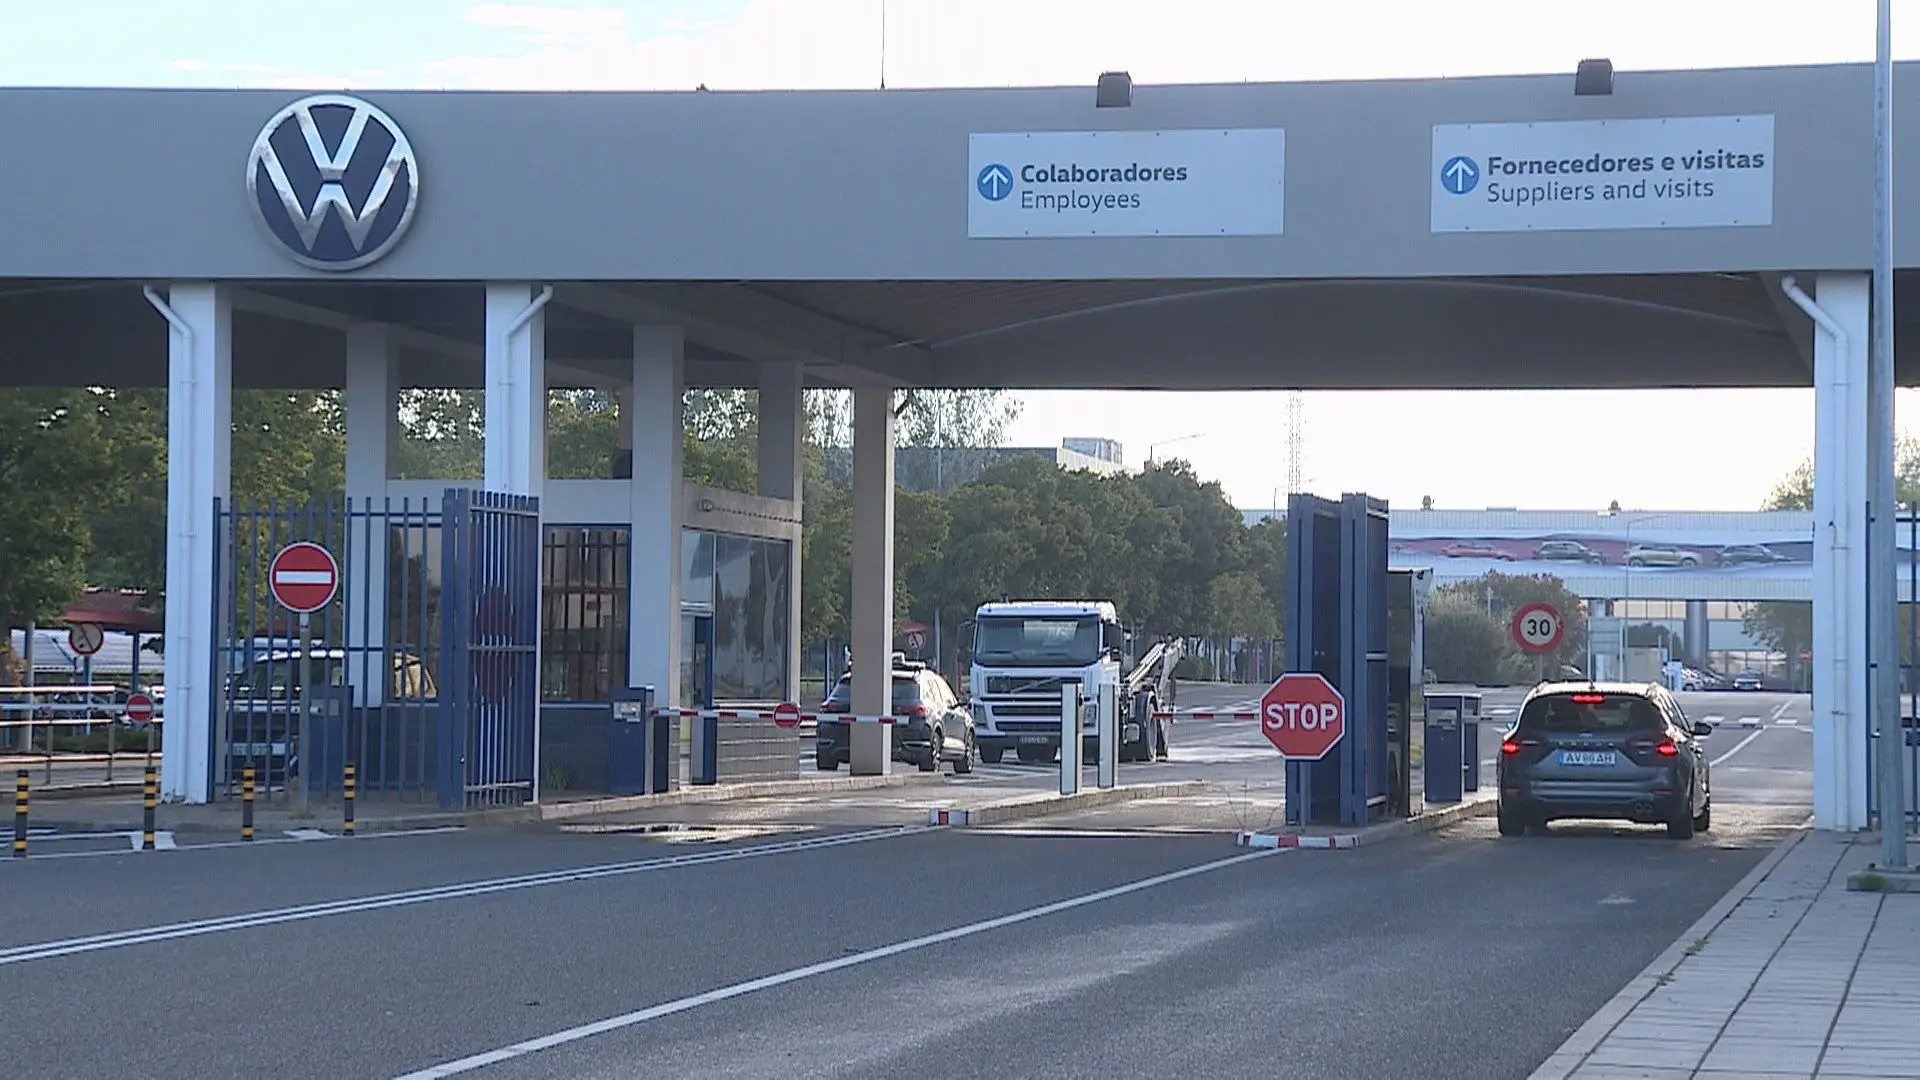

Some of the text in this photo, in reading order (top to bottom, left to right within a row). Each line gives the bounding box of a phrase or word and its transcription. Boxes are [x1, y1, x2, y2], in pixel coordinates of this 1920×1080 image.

[1020, 163, 1188, 184] Colaboradores
[1487, 148, 1766, 176] Fornecedores e visitas
[1020, 189, 1141, 213] Employees
[1486, 176, 1715, 207] Suppliers and visits
[1527, 618, 1551, 637] 30
[1265, 702, 1339, 731] STOP
